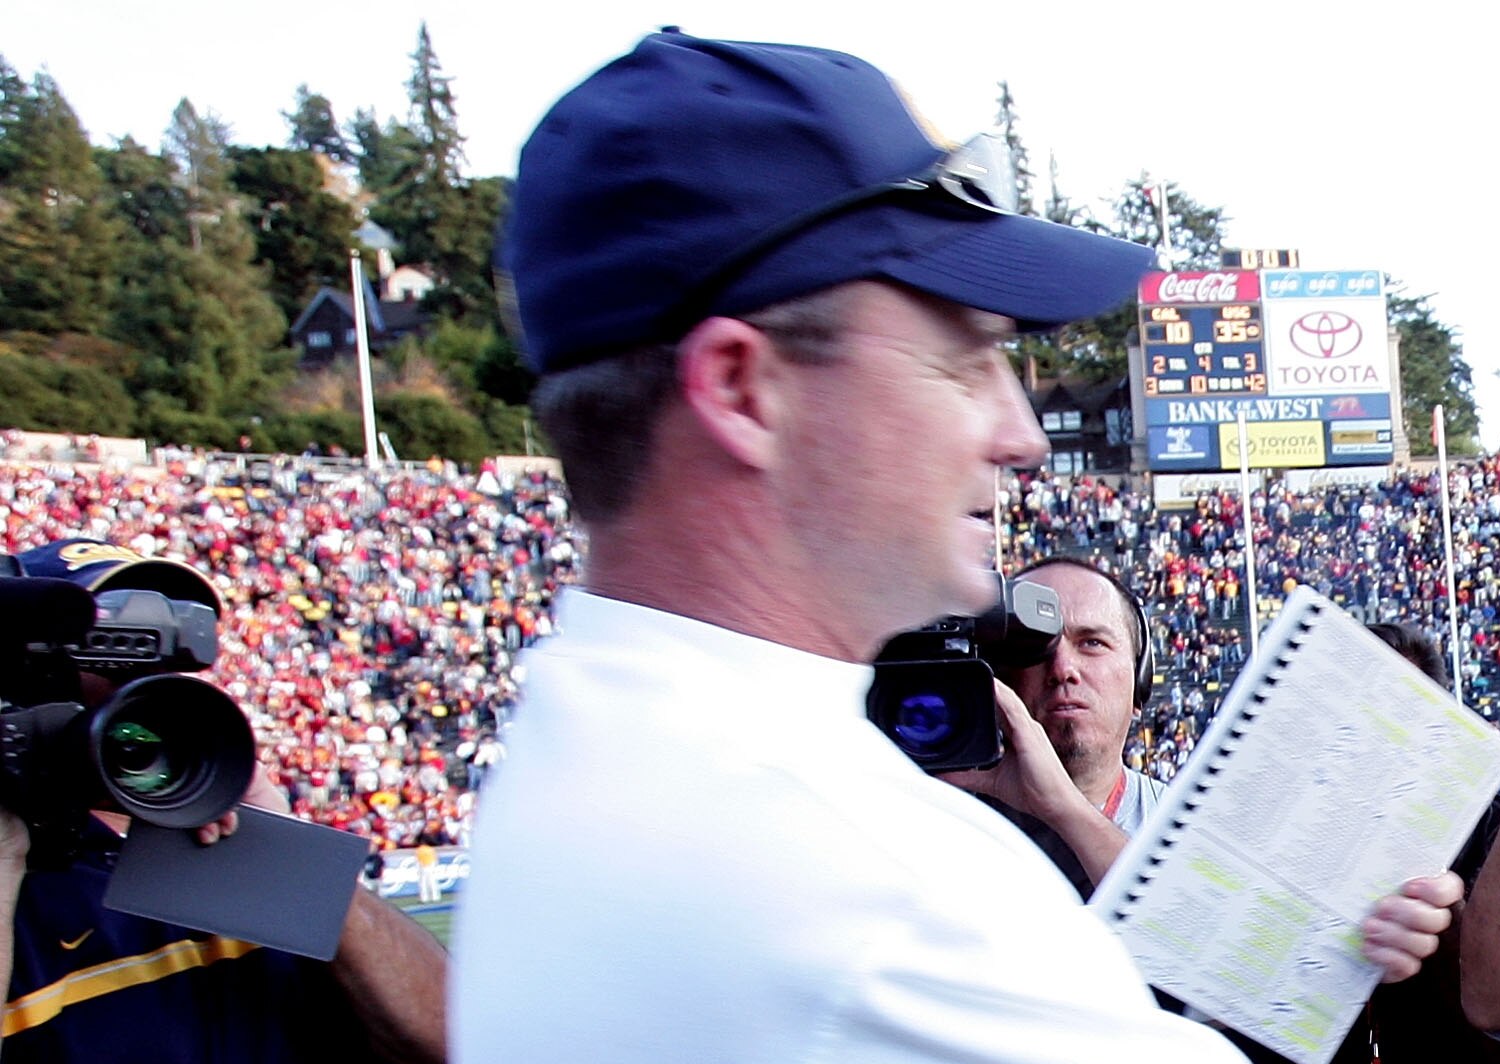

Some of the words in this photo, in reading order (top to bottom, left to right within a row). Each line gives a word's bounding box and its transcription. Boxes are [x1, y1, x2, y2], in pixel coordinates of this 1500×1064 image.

[1151, 307, 1181, 321] CAL
[1166, 320, 1191, 344] 10
[1153, 355, 1166, 374] 2
[1198, 355, 1211, 373] 4
[1244, 353, 1257, 372] 3
[1278, 365, 1380, 384] TOYOTA
[1145, 376, 1159, 395] 3
[1168, 400, 1236, 423] BANK
[1256, 397, 1323, 421] WEST
[1260, 436, 1318, 448] TOYOTA
